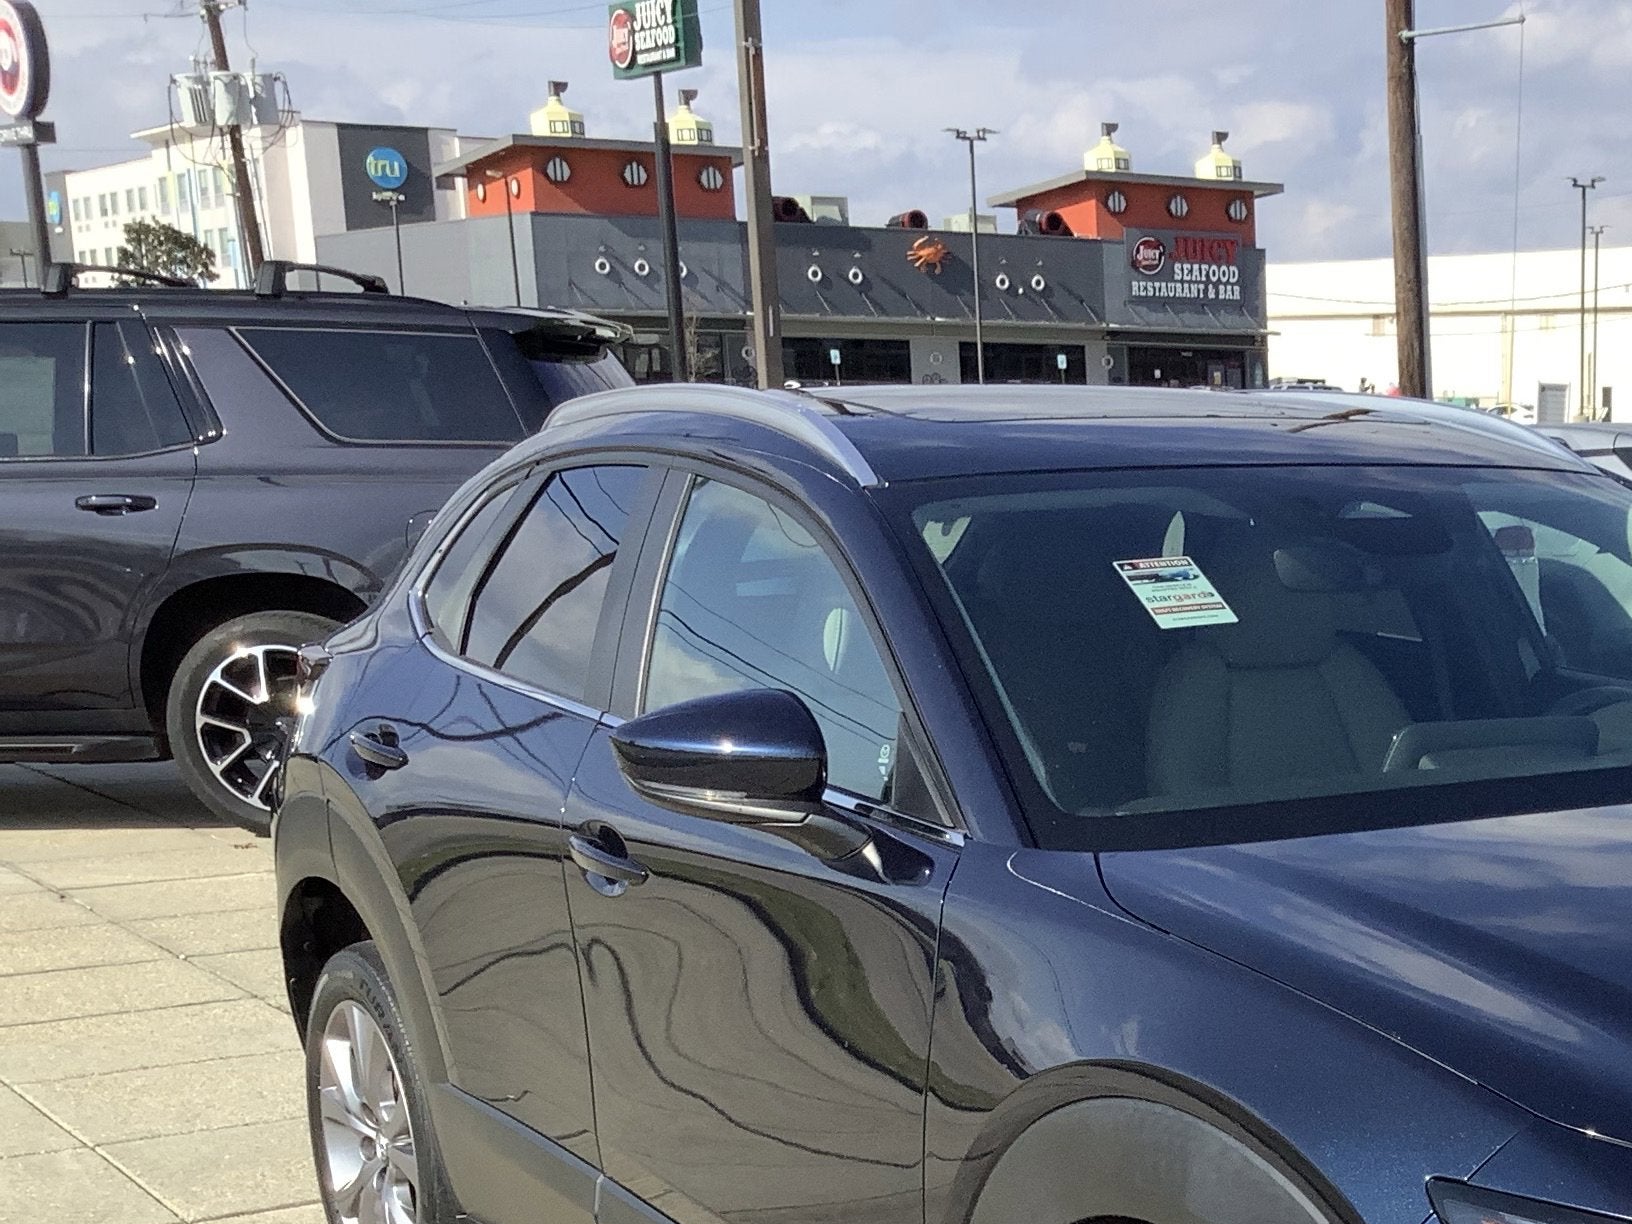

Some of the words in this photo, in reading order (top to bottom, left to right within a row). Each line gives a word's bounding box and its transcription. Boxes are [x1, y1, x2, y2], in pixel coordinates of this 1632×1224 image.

[633, 0, 673, 31] JUICY
[634, 24, 676, 51] SEAFOOD
[368, 156, 401, 178] tru
[1137, 245, 1160, 261] JUICY
[1169, 237, 1237, 262] JUICY
[1174, 263, 1239, 283] SEAFOOD
[1131, 280, 1205, 298] RESTAURANT
[1207, 283, 1216, 299] &
[1218, 285, 1241, 300] BAR
[1138, 559, 1189, 569] ATTENTION
